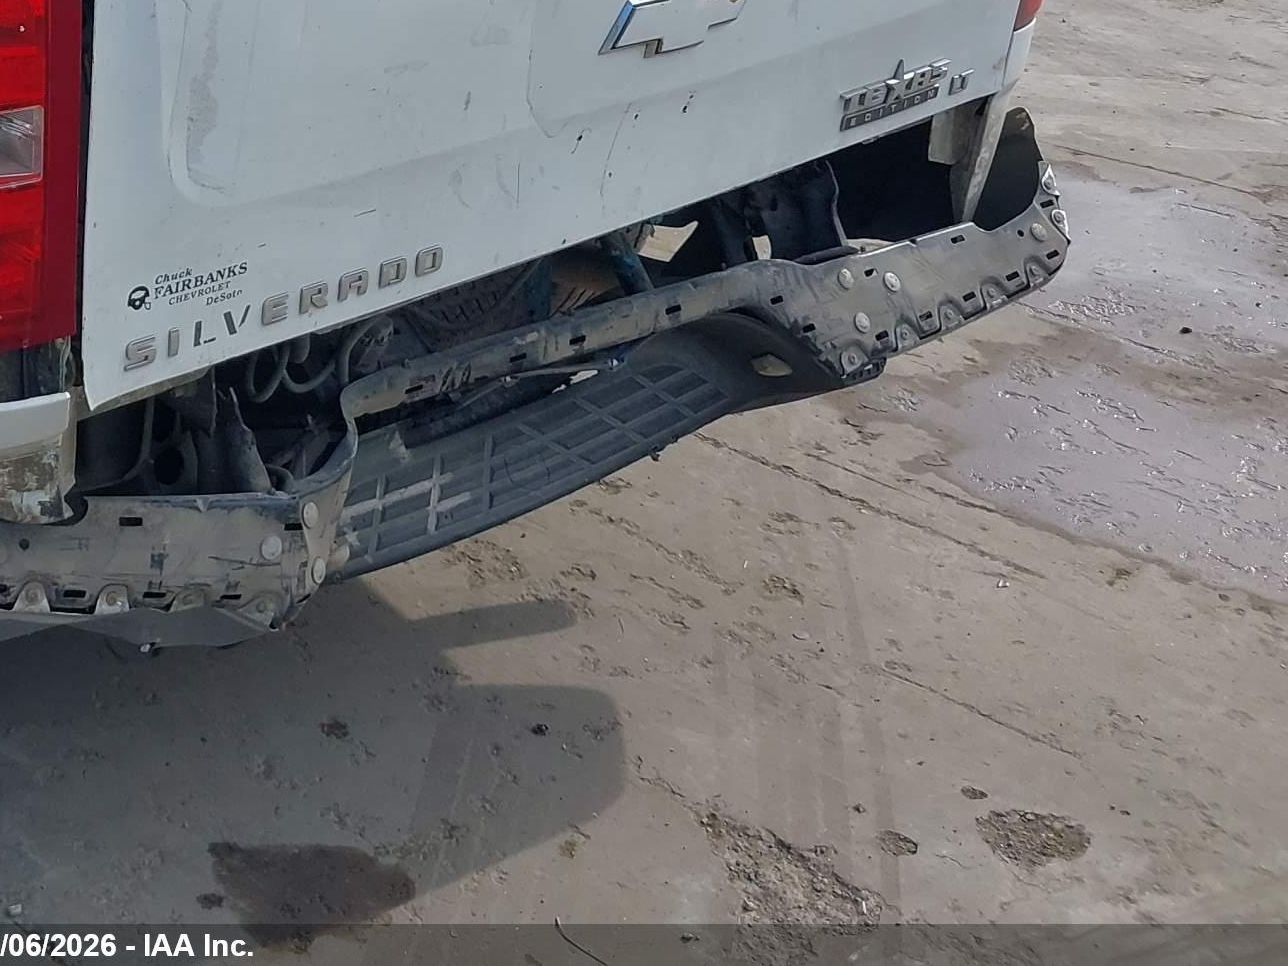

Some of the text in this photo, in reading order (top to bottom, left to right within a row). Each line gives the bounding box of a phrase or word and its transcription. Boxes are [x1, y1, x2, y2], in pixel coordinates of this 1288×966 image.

[840, 57, 951, 113] TEXAS
[849, 90, 936, 126] EDITION
[153, 261, 249, 300] FAIRBANKS
[154, 267, 193, 285] Chuck
[168, 280, 231, 306] CHEVROLET
[123, 244, 444, 372] SILVERADO
